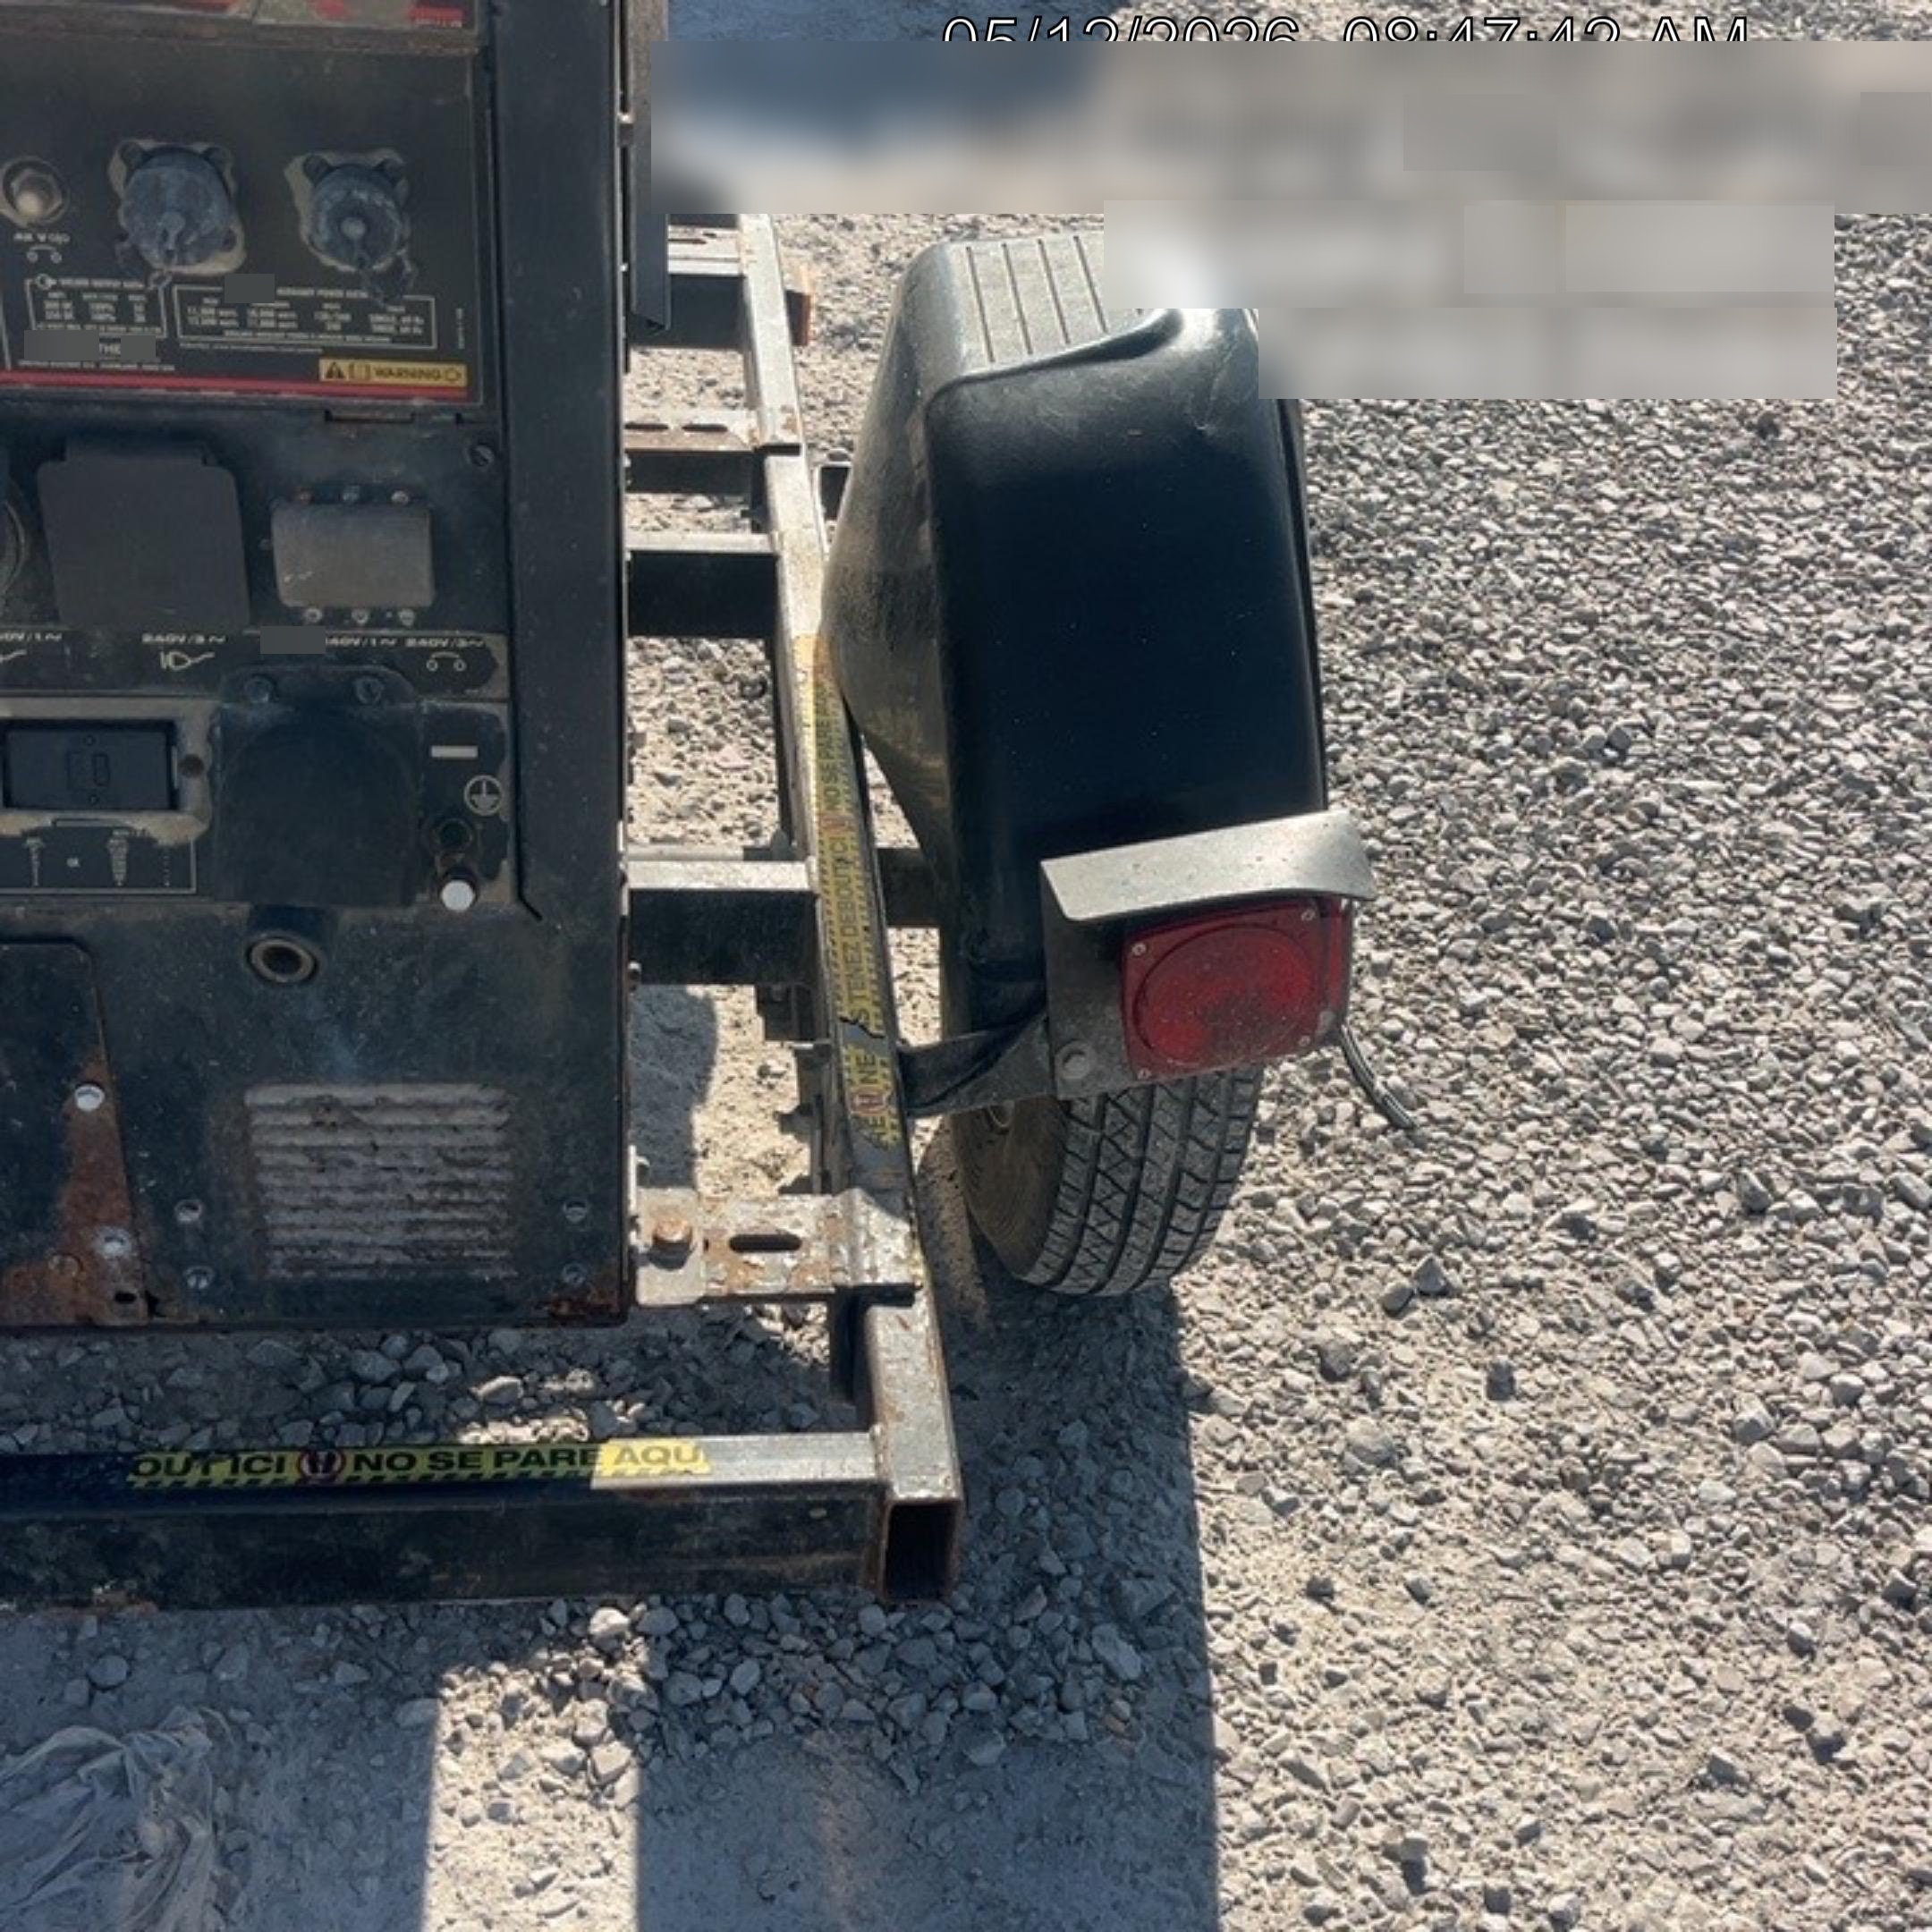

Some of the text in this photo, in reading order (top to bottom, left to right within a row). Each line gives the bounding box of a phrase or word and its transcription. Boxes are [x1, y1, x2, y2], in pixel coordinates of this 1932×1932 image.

[373, 366, 441, 381] WARNING
[823, 786, 843, 811] NO
[843, 941, 870, 1004] TENEZ
[228, 1454, 286, 1476] ICI
[353, 1452, 418, 1472] NO
[427, 1448, 484, 1472] SE
[493, 1447, 602, 1470] PARE
